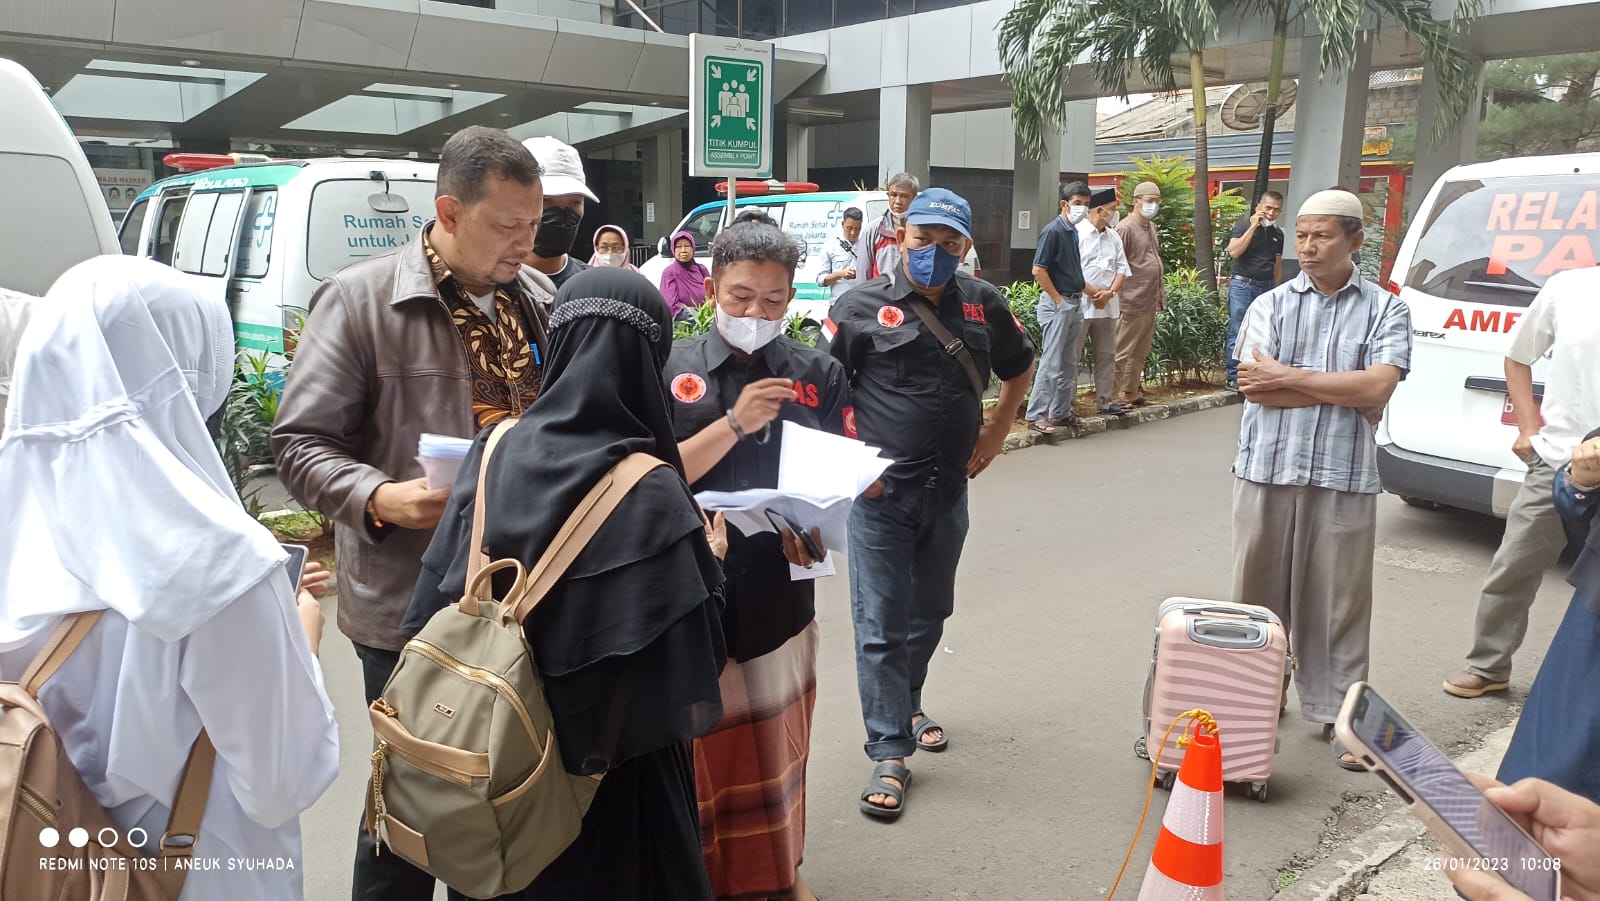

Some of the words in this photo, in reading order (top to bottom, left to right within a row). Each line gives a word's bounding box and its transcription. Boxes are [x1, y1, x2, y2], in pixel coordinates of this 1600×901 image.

[709, 139, 726, 147] TITIK
[728, 140, 757, 149] KUMPUL
[710, 151, 739, 159] ASSEMBLY
[120, 177, 147, 185] MASKER
[928, 201, 961, 214] KOMPAS
[1487, 189, 1598, 231] RELA
[343, 214, 406, 229] Rumah
[347, 233, 397, 248] untuk
[804, 231, 827, 240] Jakarta
[1486, 235, 1597, 276] PA
[962, 302, 987, 325] PAS
[777, 379, 819, 408] AS
